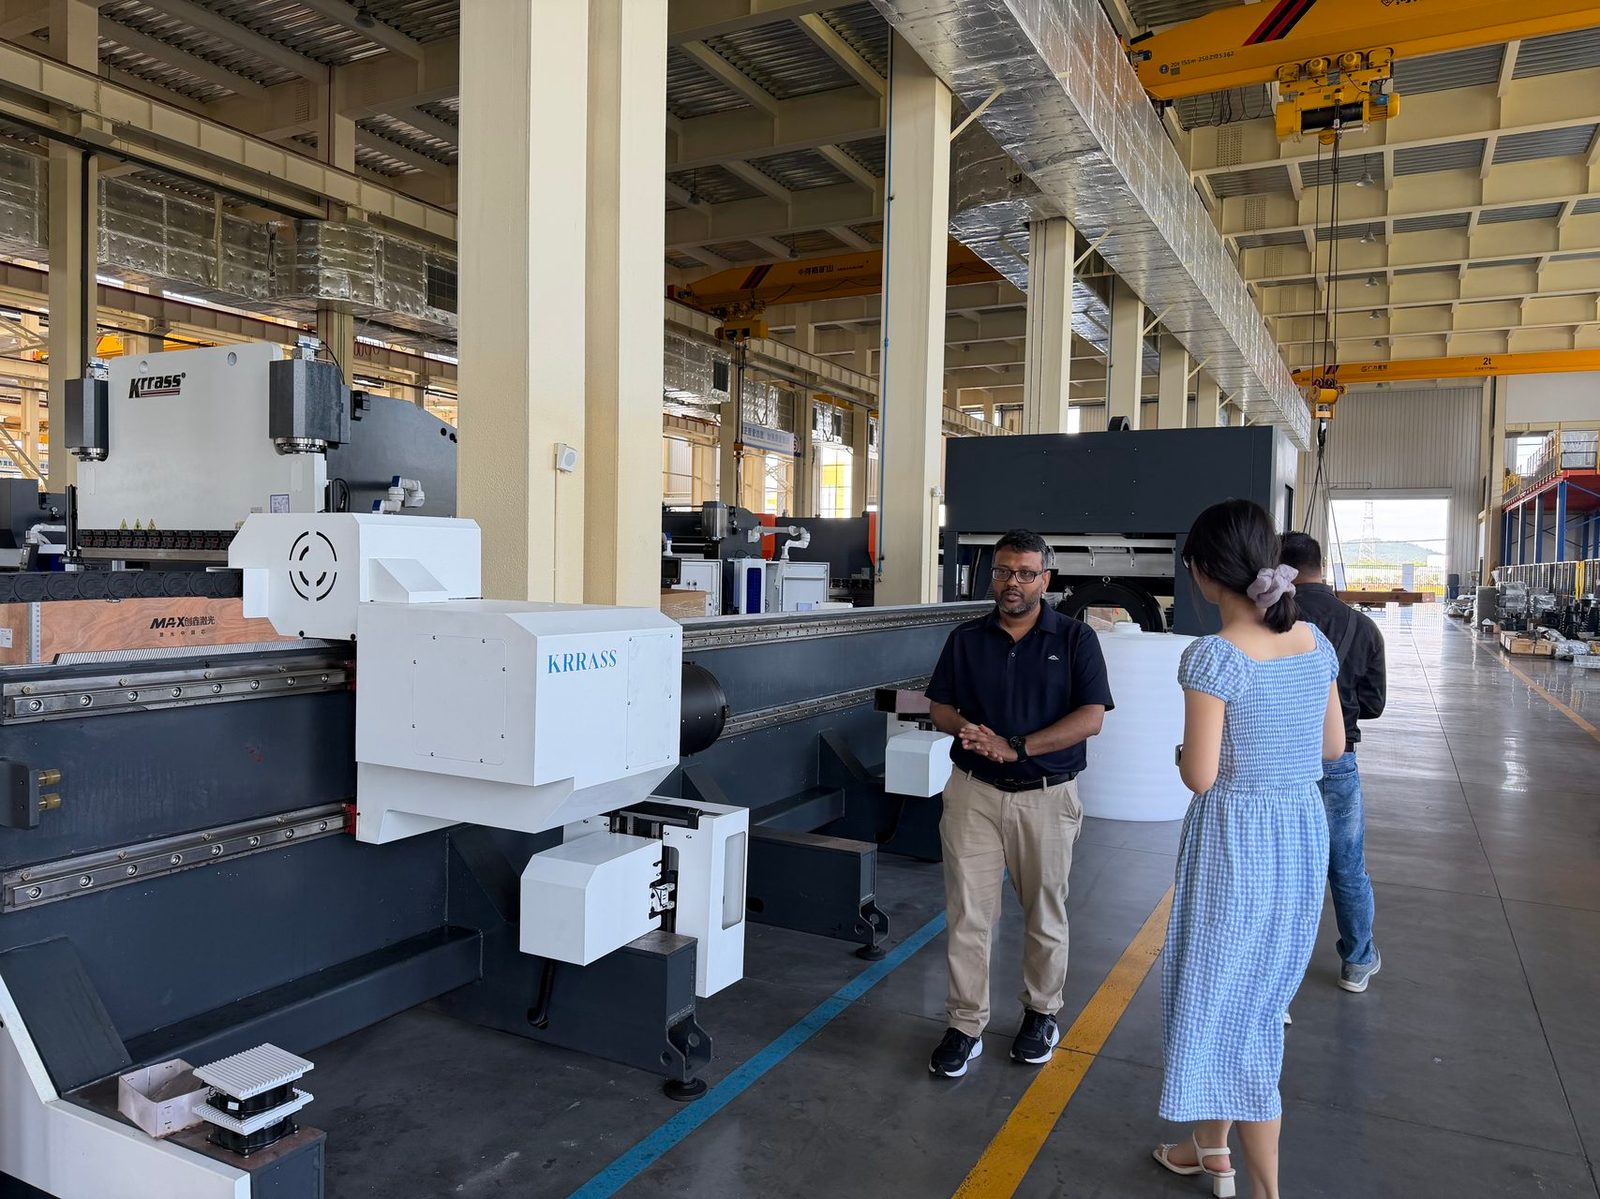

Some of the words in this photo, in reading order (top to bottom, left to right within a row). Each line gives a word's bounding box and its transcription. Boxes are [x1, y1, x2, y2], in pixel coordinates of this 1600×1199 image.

[1483, 357, 1492, 366] 2t
[128, 374, 182, 399] Krrass
[149, 616, 185, 630] MAX
[547, 649, 618, 674] KRRASS
